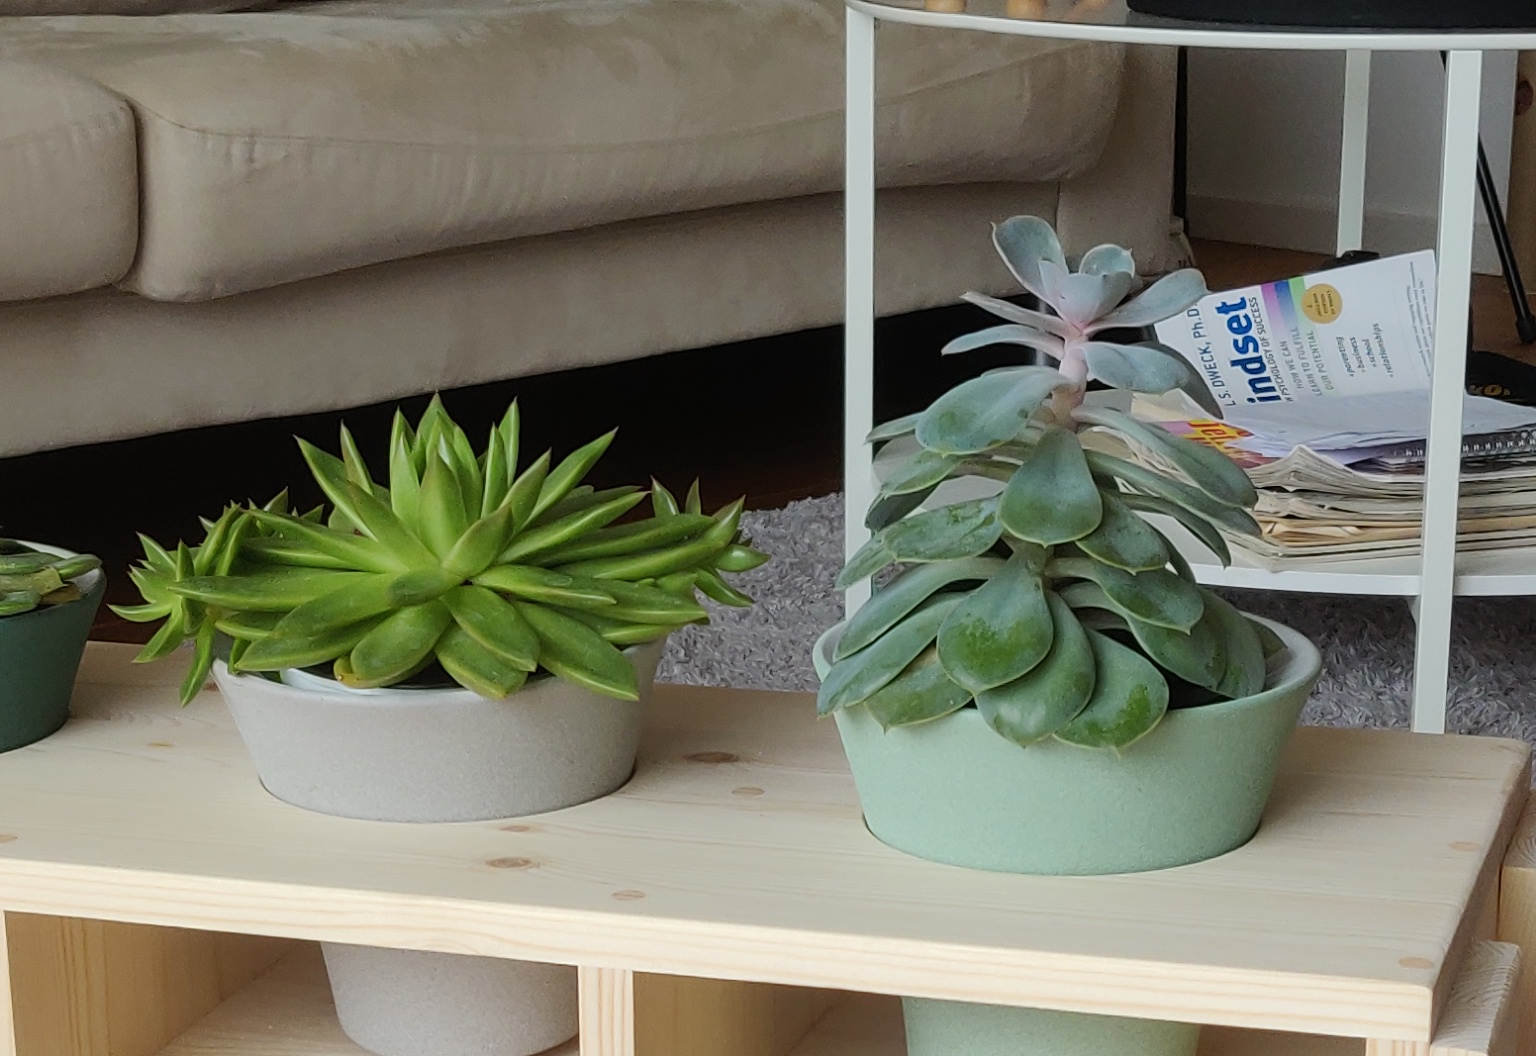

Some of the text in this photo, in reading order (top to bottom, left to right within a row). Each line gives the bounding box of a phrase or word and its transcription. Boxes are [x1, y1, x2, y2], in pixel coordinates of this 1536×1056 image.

[1249, 296, 1267, 335] SUCCESS
[1214, 296, 1282, 404] indset
[1260, 335, 1271, 347] OF
[1289, 325, 1324, 398] LEARN TO FULFILL
[1305, 329, 1327, 373] POTENTIAL
[1336, 336, 1355, 374] parenting
[1349, 336, 1365, 370] business
[1361, 338, 1377, 363] school
[1372, 323, 1394, 374] relationships
[1197, 341, 1226, 388] DWECK,
[1263, 348, 1292, 397] PSYCHOLOGY
[1278, 340, 1305, 390] HOW WE CAN
[1321, 373, 1335, 391] OUR
